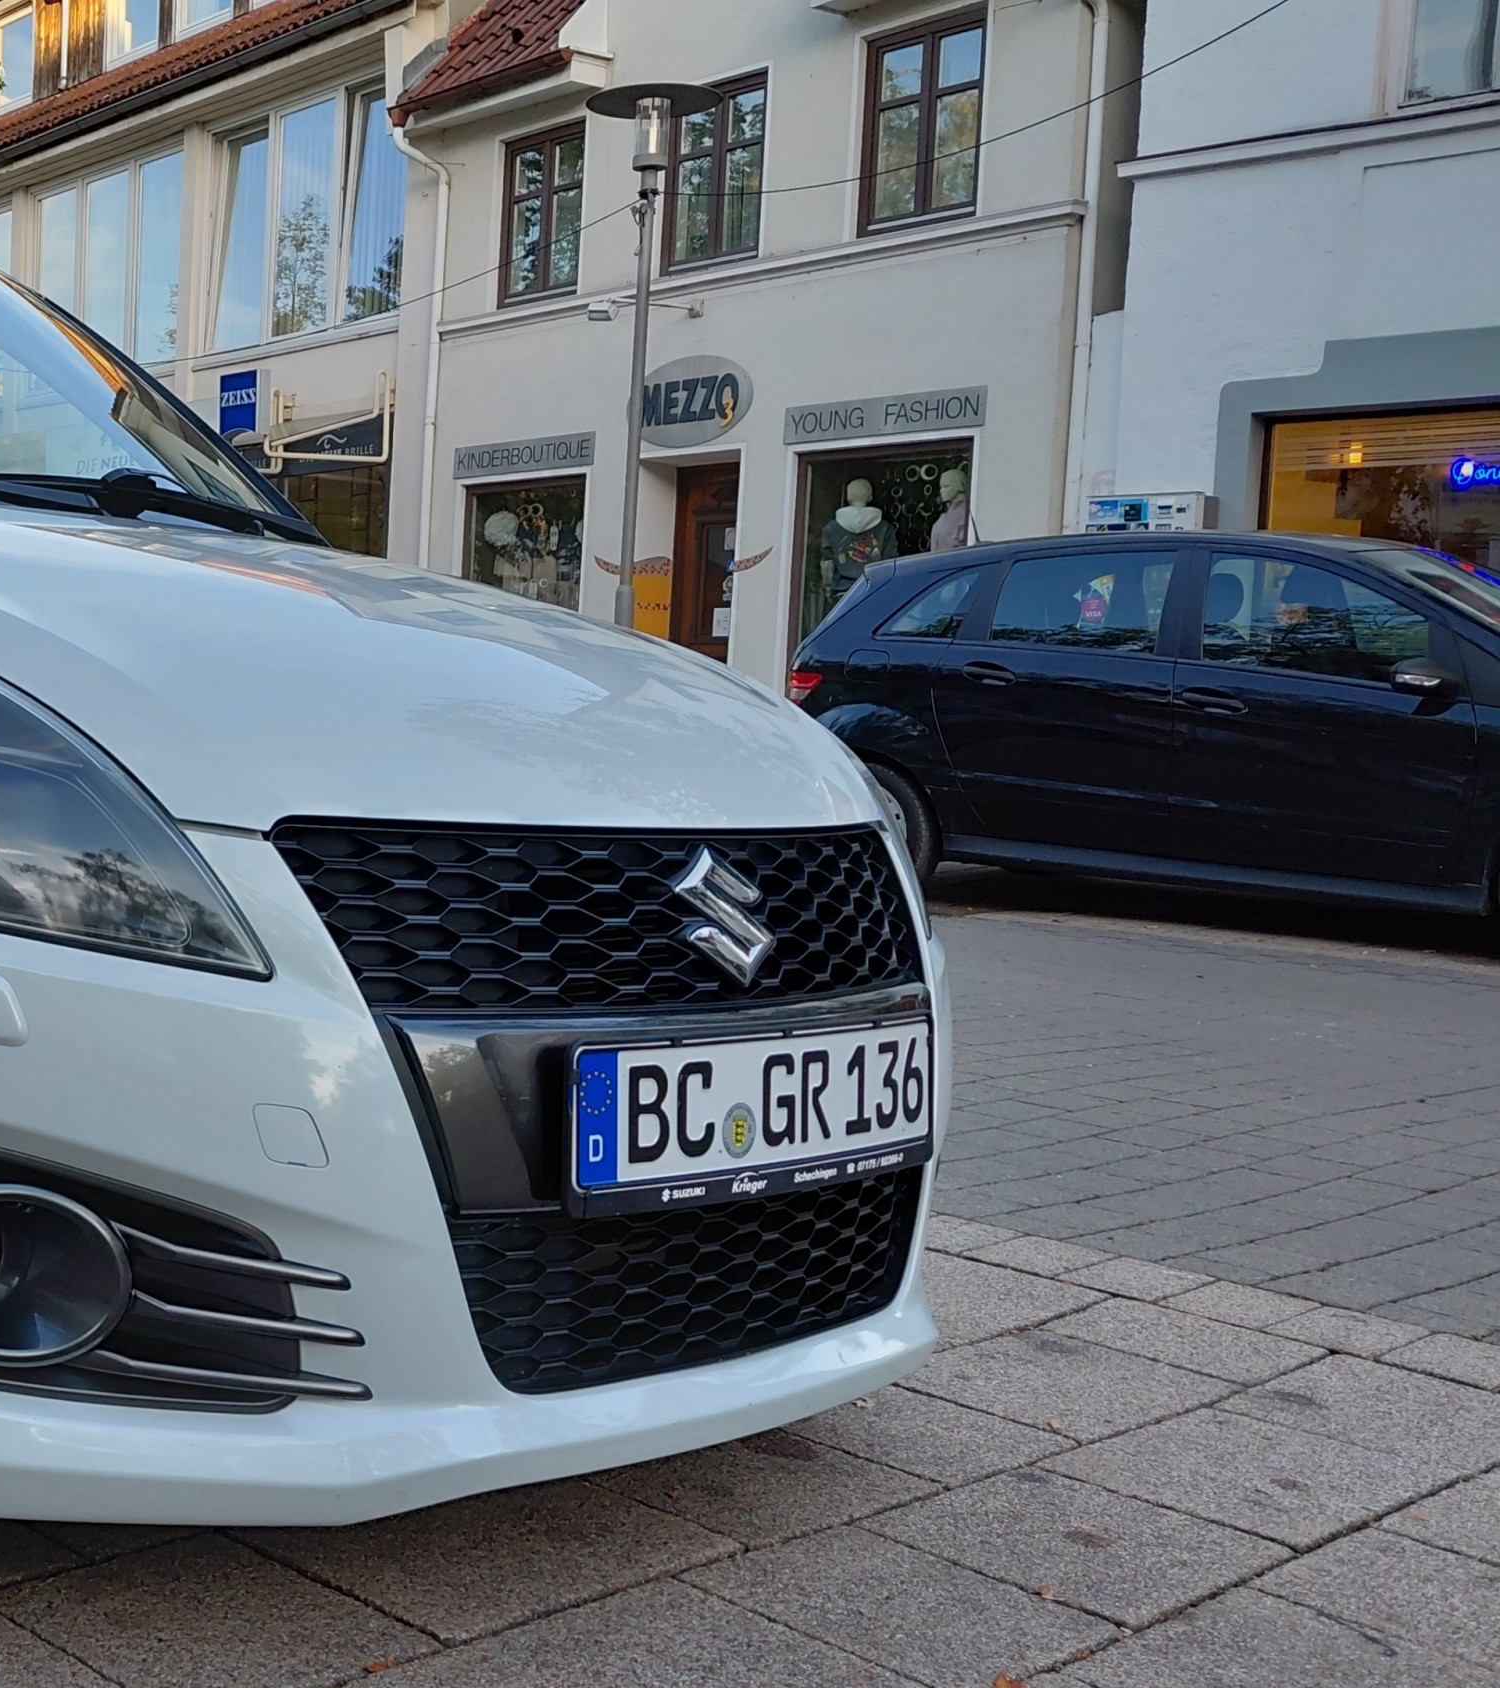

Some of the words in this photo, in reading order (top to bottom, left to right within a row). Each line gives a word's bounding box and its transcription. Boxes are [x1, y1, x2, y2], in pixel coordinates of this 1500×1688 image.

[221, 387, 257, 408] ZEISS
[641, 372, 739, 428] MEZZO
[790, 406, 864, 436] YOUNG
[883, 393, 981, 427] FASHION
[344, 443, 375, 456] BRILLE
[457, 438, 592, 472] KINDERBOUTIQUE
[76, 457, 98, 475] DIE
[1452, 460, 1500, 485] Dön
[1085, 610, 1102, 618] VISA
[628, 1060, 716, 1164] BC
[762, 1049, 831, 1147] GR
[845, 1036, 924, 1136] 136
[588, 1134, 604, 1163] D
[671, 1186, 706, 1199] SUZUKI
[731, 1176, 768, 1195] Krieger
[793, 1167, 838, 1183] Schechingen
